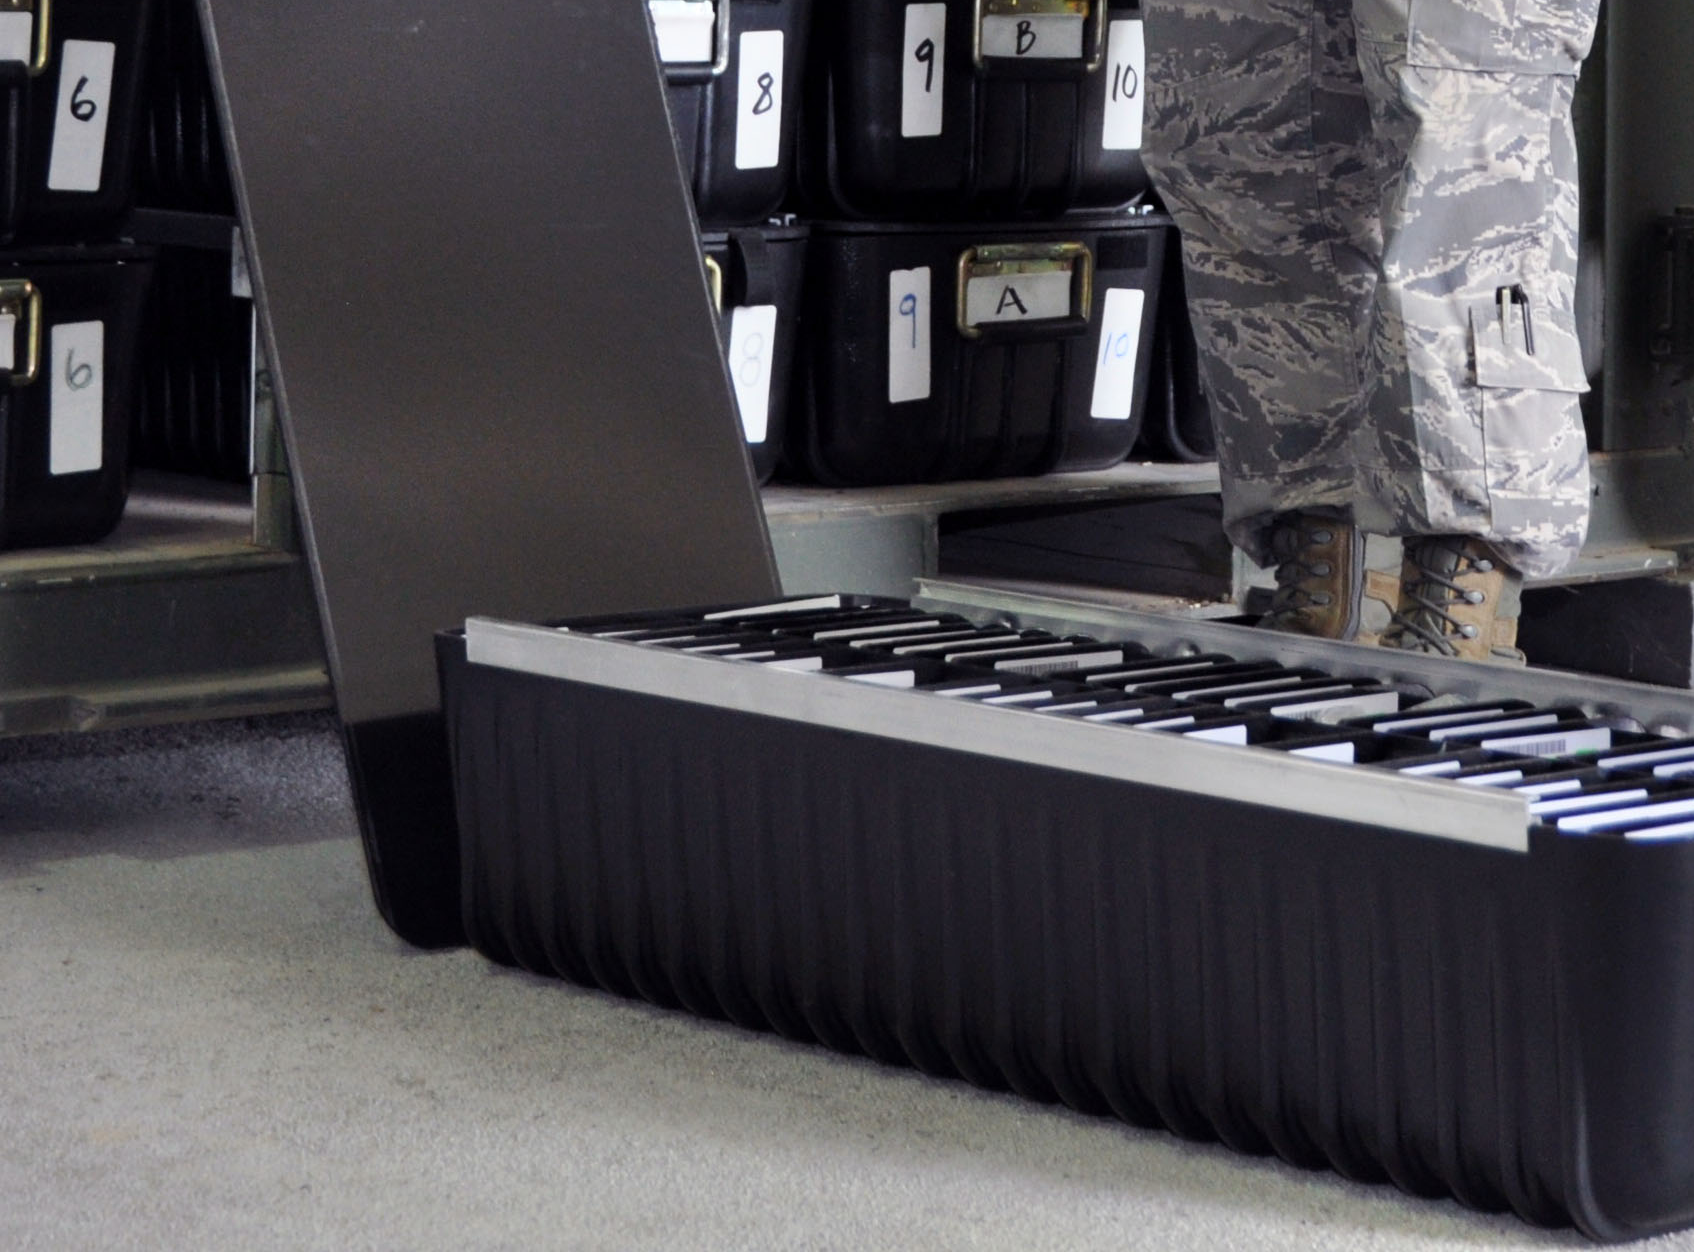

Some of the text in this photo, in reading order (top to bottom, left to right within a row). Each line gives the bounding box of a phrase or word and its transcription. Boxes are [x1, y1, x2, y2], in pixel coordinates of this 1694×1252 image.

[1015, 21, 1036, 56] B
[914, 38, 936, 93] 9
[1112, 62, 1138, 102] 10
[70, 76, 97, 122] 6
[751, 72, 774, 116] 8
[899, 293, 917, 348] 9
[995, 285, 1028, 316] A
[1103, 331, 1129, 366] 10
[65, 349, 93, 389] 6
